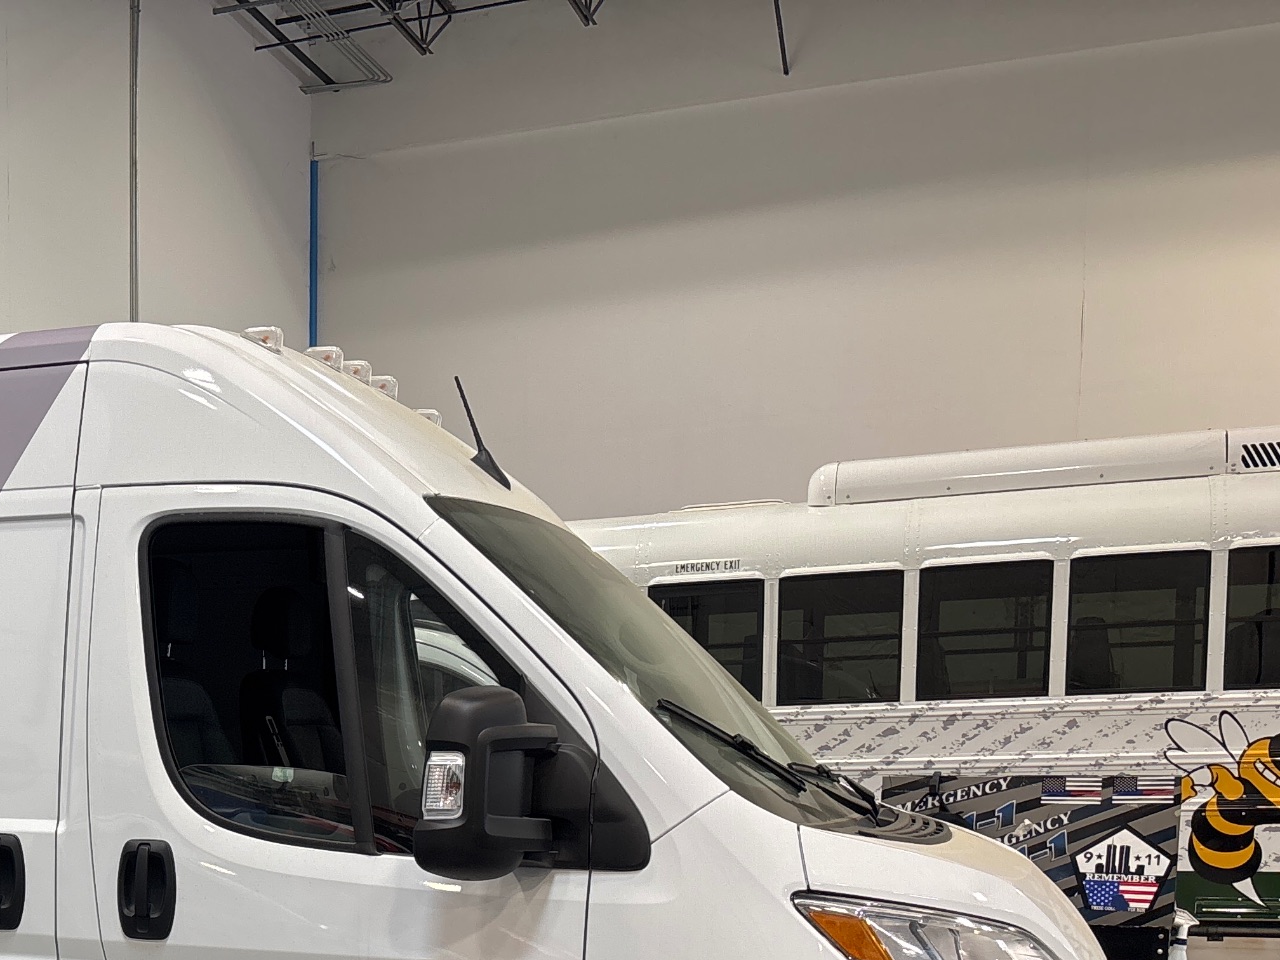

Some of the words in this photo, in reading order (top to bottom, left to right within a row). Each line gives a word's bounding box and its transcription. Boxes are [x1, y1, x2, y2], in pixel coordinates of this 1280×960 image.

[675, 560, 721, 574] EMERGENCY
[723, 559, 741, 570] EXIT
[1083, 851, 1094, 864] 9
[1144, 853, 1161, 867] 11
[1084, 873, 1157, 884] REMEMBER
